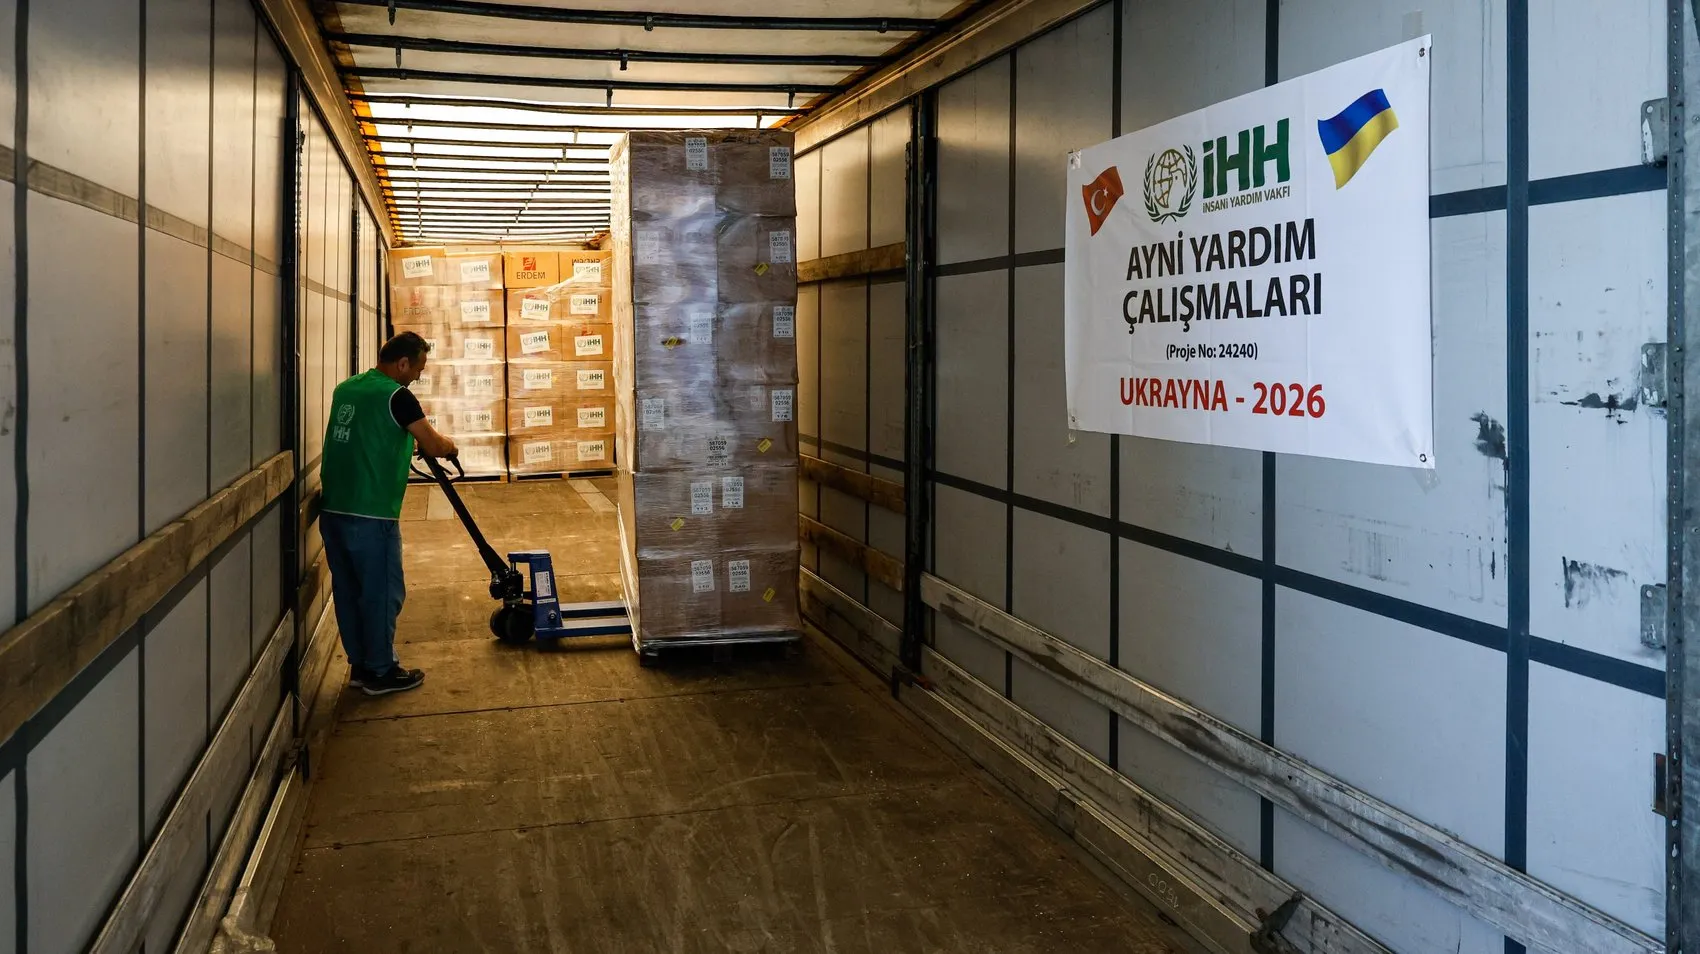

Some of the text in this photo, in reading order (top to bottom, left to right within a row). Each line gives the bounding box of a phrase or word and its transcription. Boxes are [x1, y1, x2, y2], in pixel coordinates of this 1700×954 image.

[1230, 191, 1262, 208] YARDIM
[1264, 185, 1290, 201] VAKFI
[1126, 218, 1316, 280] AYNİ YARDIM
[516, 271, 546, 280] ERDEM
[1122, 272, 1322, 335] ÇALIŞMALARI
[1166, 342, 1258, 361] (Proje No: 24240)
[1120, 377, 1228, 412] UKRAYNA
[1252, 381, 1326, 418] 2026
